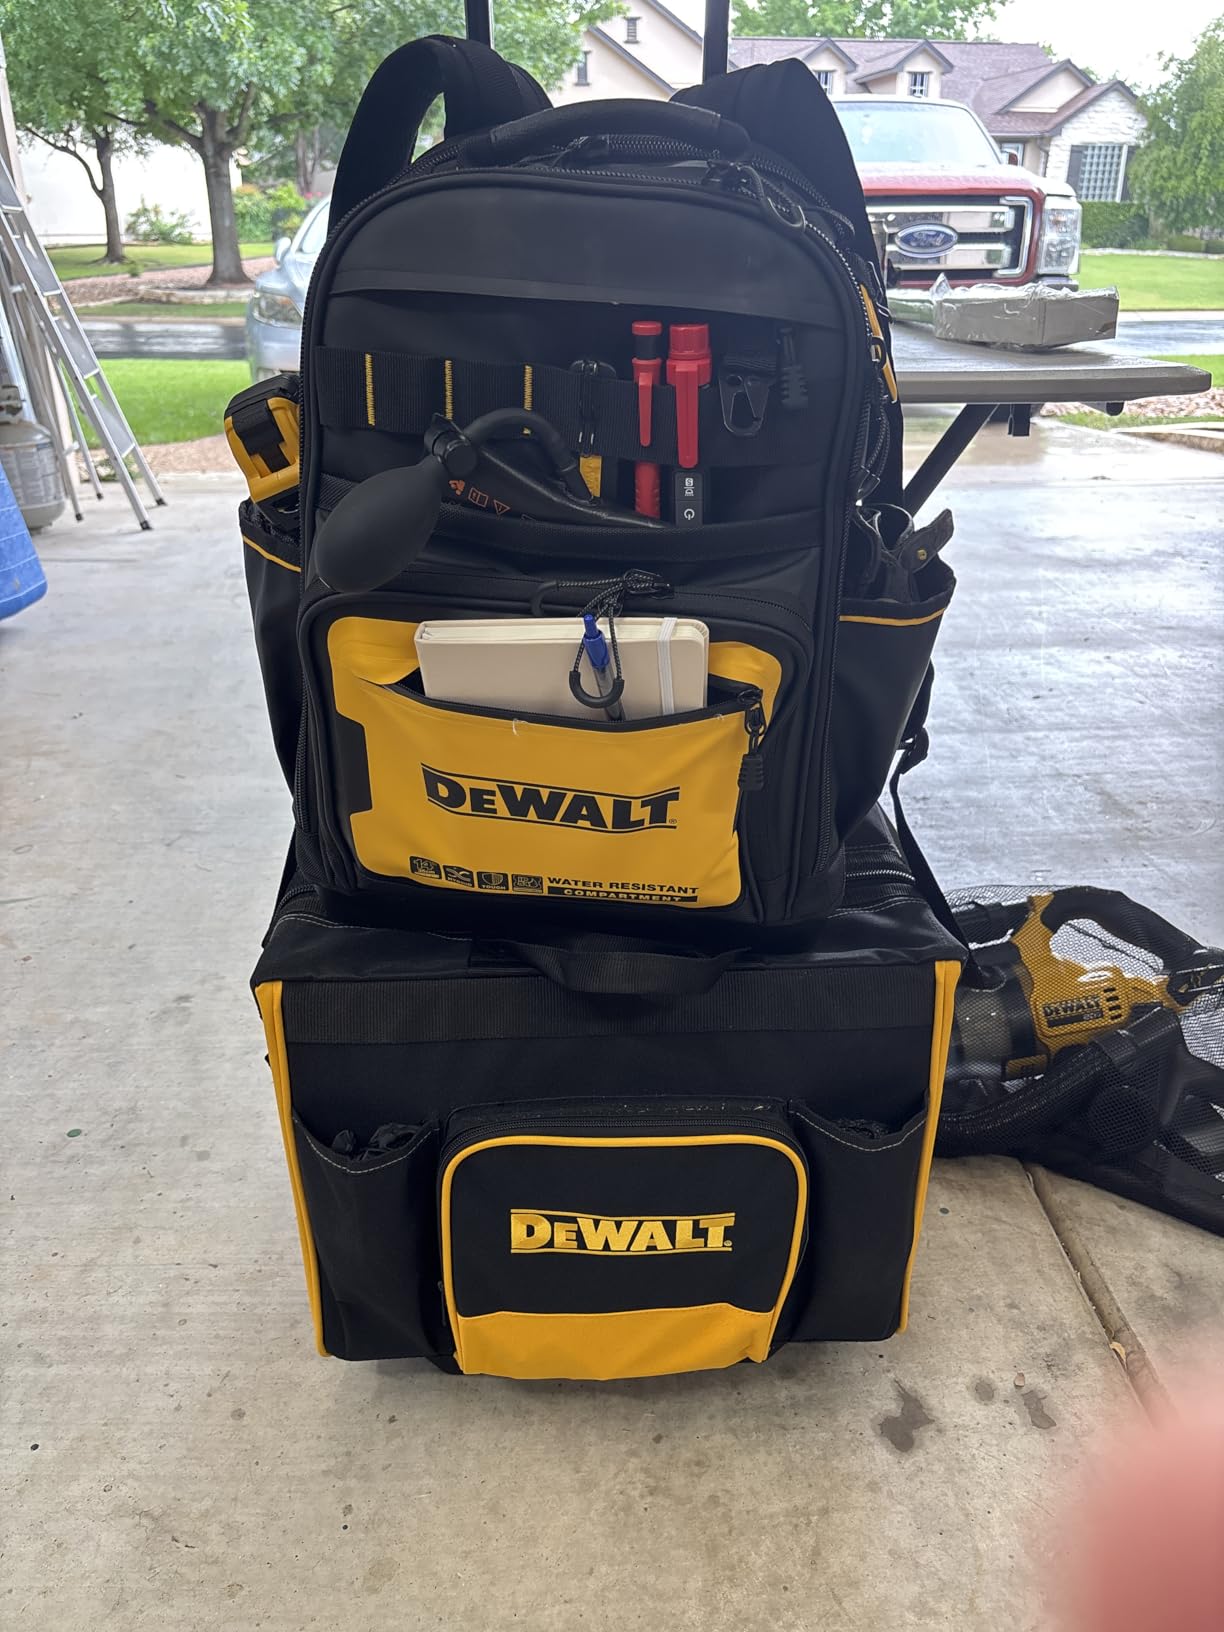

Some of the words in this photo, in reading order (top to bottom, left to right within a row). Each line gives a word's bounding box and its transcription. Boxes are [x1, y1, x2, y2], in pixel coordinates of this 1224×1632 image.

[421, 765, 679, 830] DEWALT
[548, 876, 603, 888] WATER
[609, 882, 699, 895] RESISTANT
[564, 889, 681, 902] COMPARTMENT
[510, 1212, 736, 1252] DEWALT
